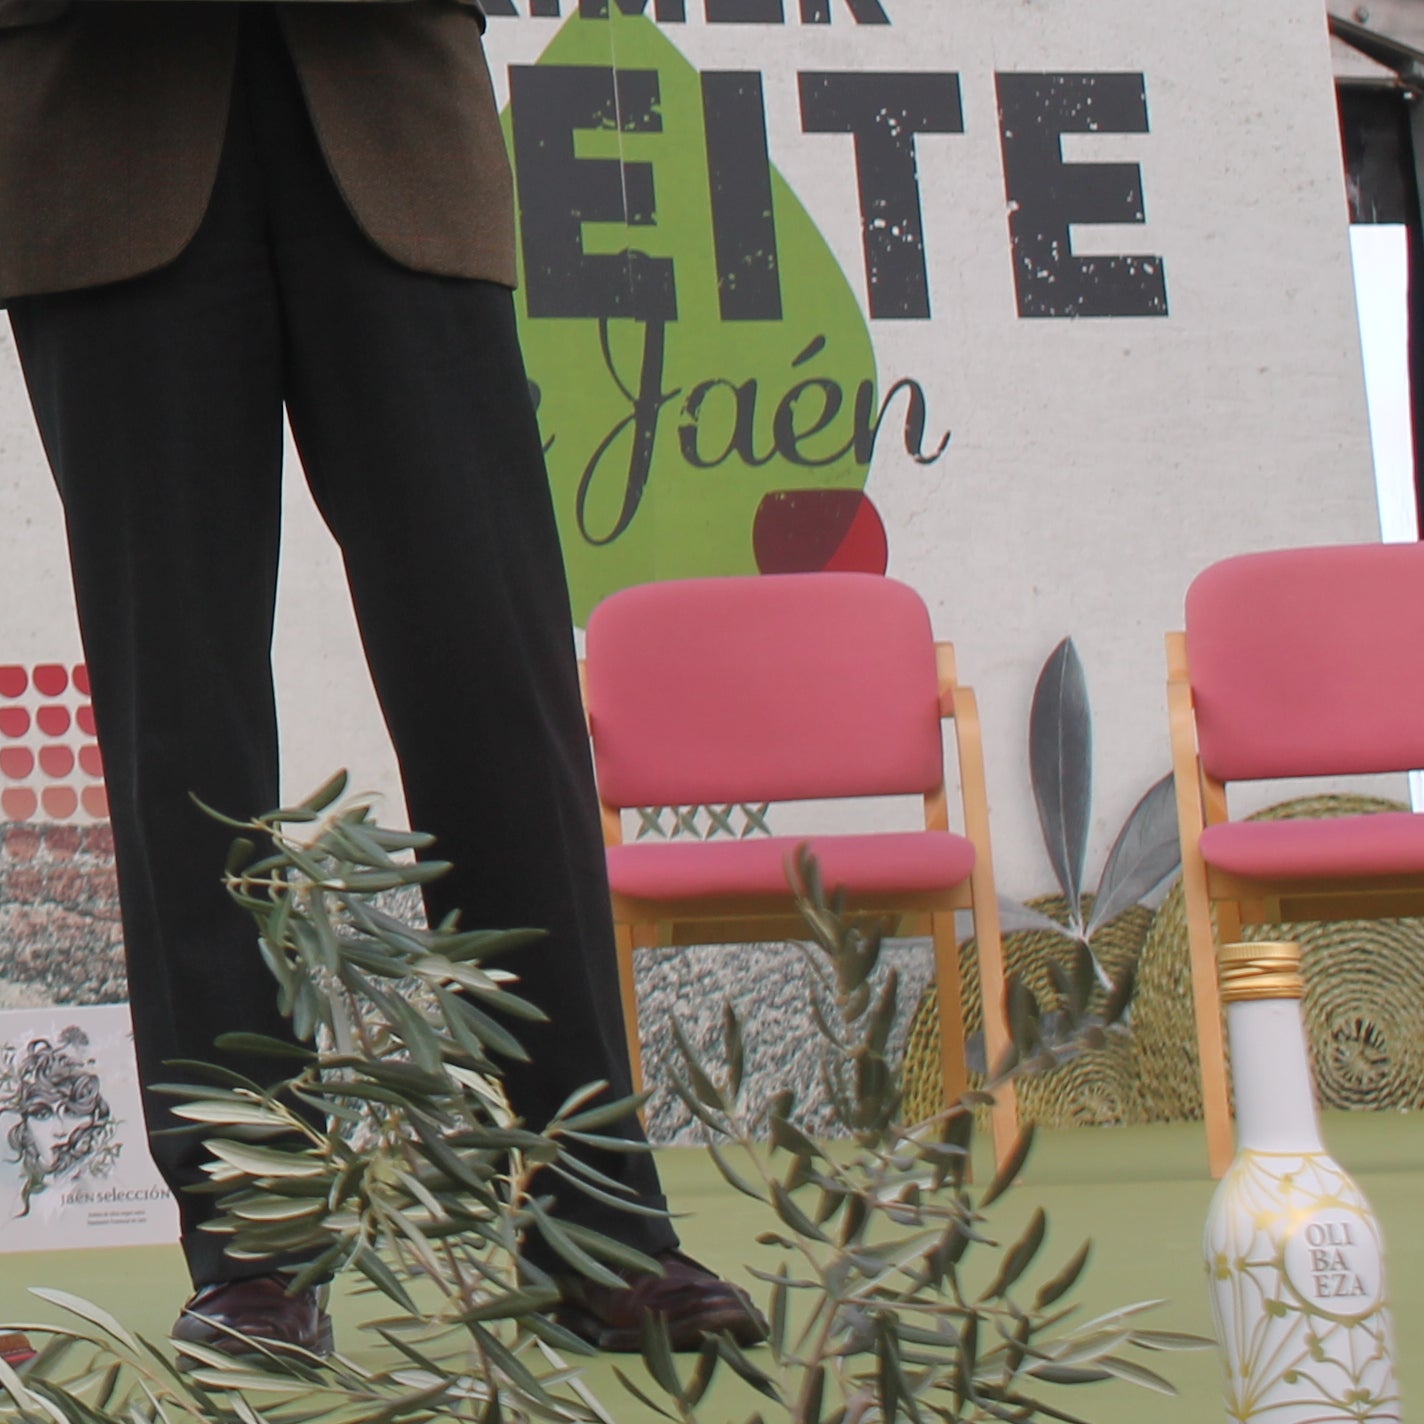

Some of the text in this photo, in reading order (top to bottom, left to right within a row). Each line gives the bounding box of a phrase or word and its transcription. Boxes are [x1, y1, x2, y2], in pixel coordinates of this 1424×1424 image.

[576, 319, 952, 548] Jaén
[1305, 1222, 1355, 1247] OLI
[1310, 1249, 1349, 1272] BA
[1314, 1274, 1367, 1298] EZA
